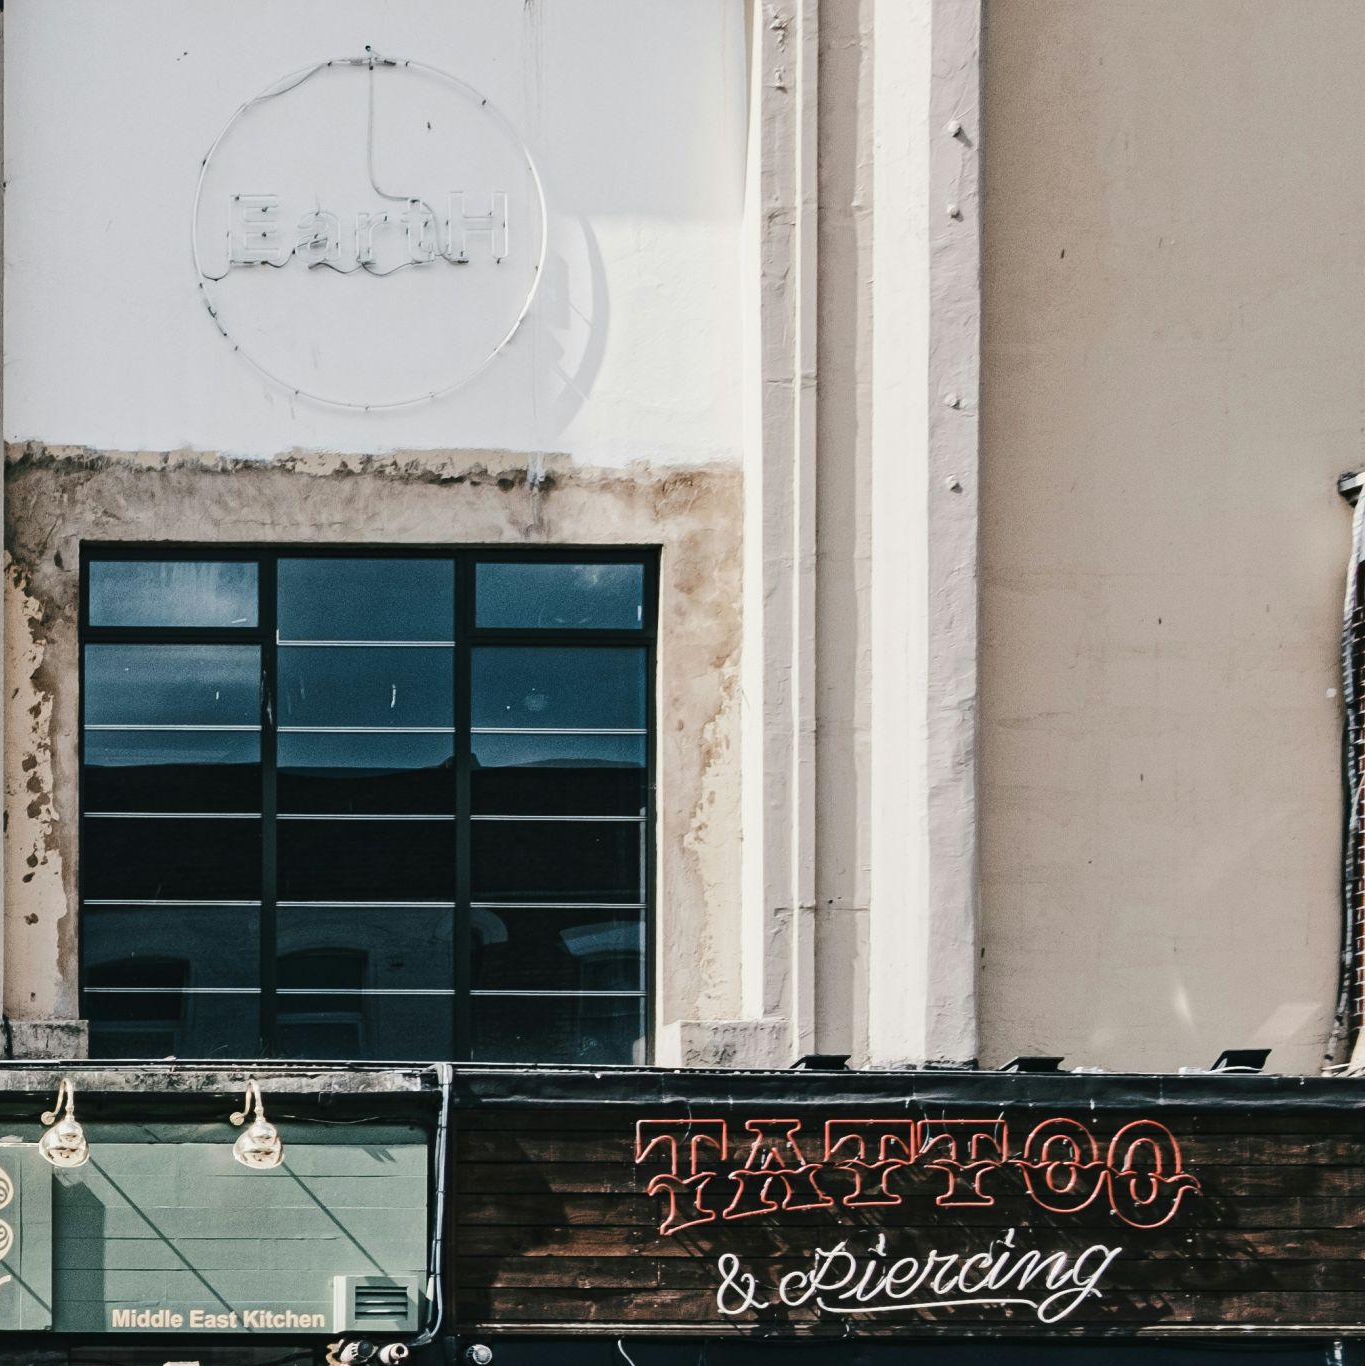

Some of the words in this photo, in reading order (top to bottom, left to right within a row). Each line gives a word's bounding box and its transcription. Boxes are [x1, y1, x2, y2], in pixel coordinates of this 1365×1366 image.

[225, 190, 510, 267] EartH
[635, 1117, 1202, 1237] TATTOO
[112, 1308, 184, 1329] Middle
[188, 1308, 239, 1329] East
[242, 1308, 326, 1329] Kitchen
[716, 1252, 770, 1315] &
[779, 1227, 1123, 1324] Piercing
